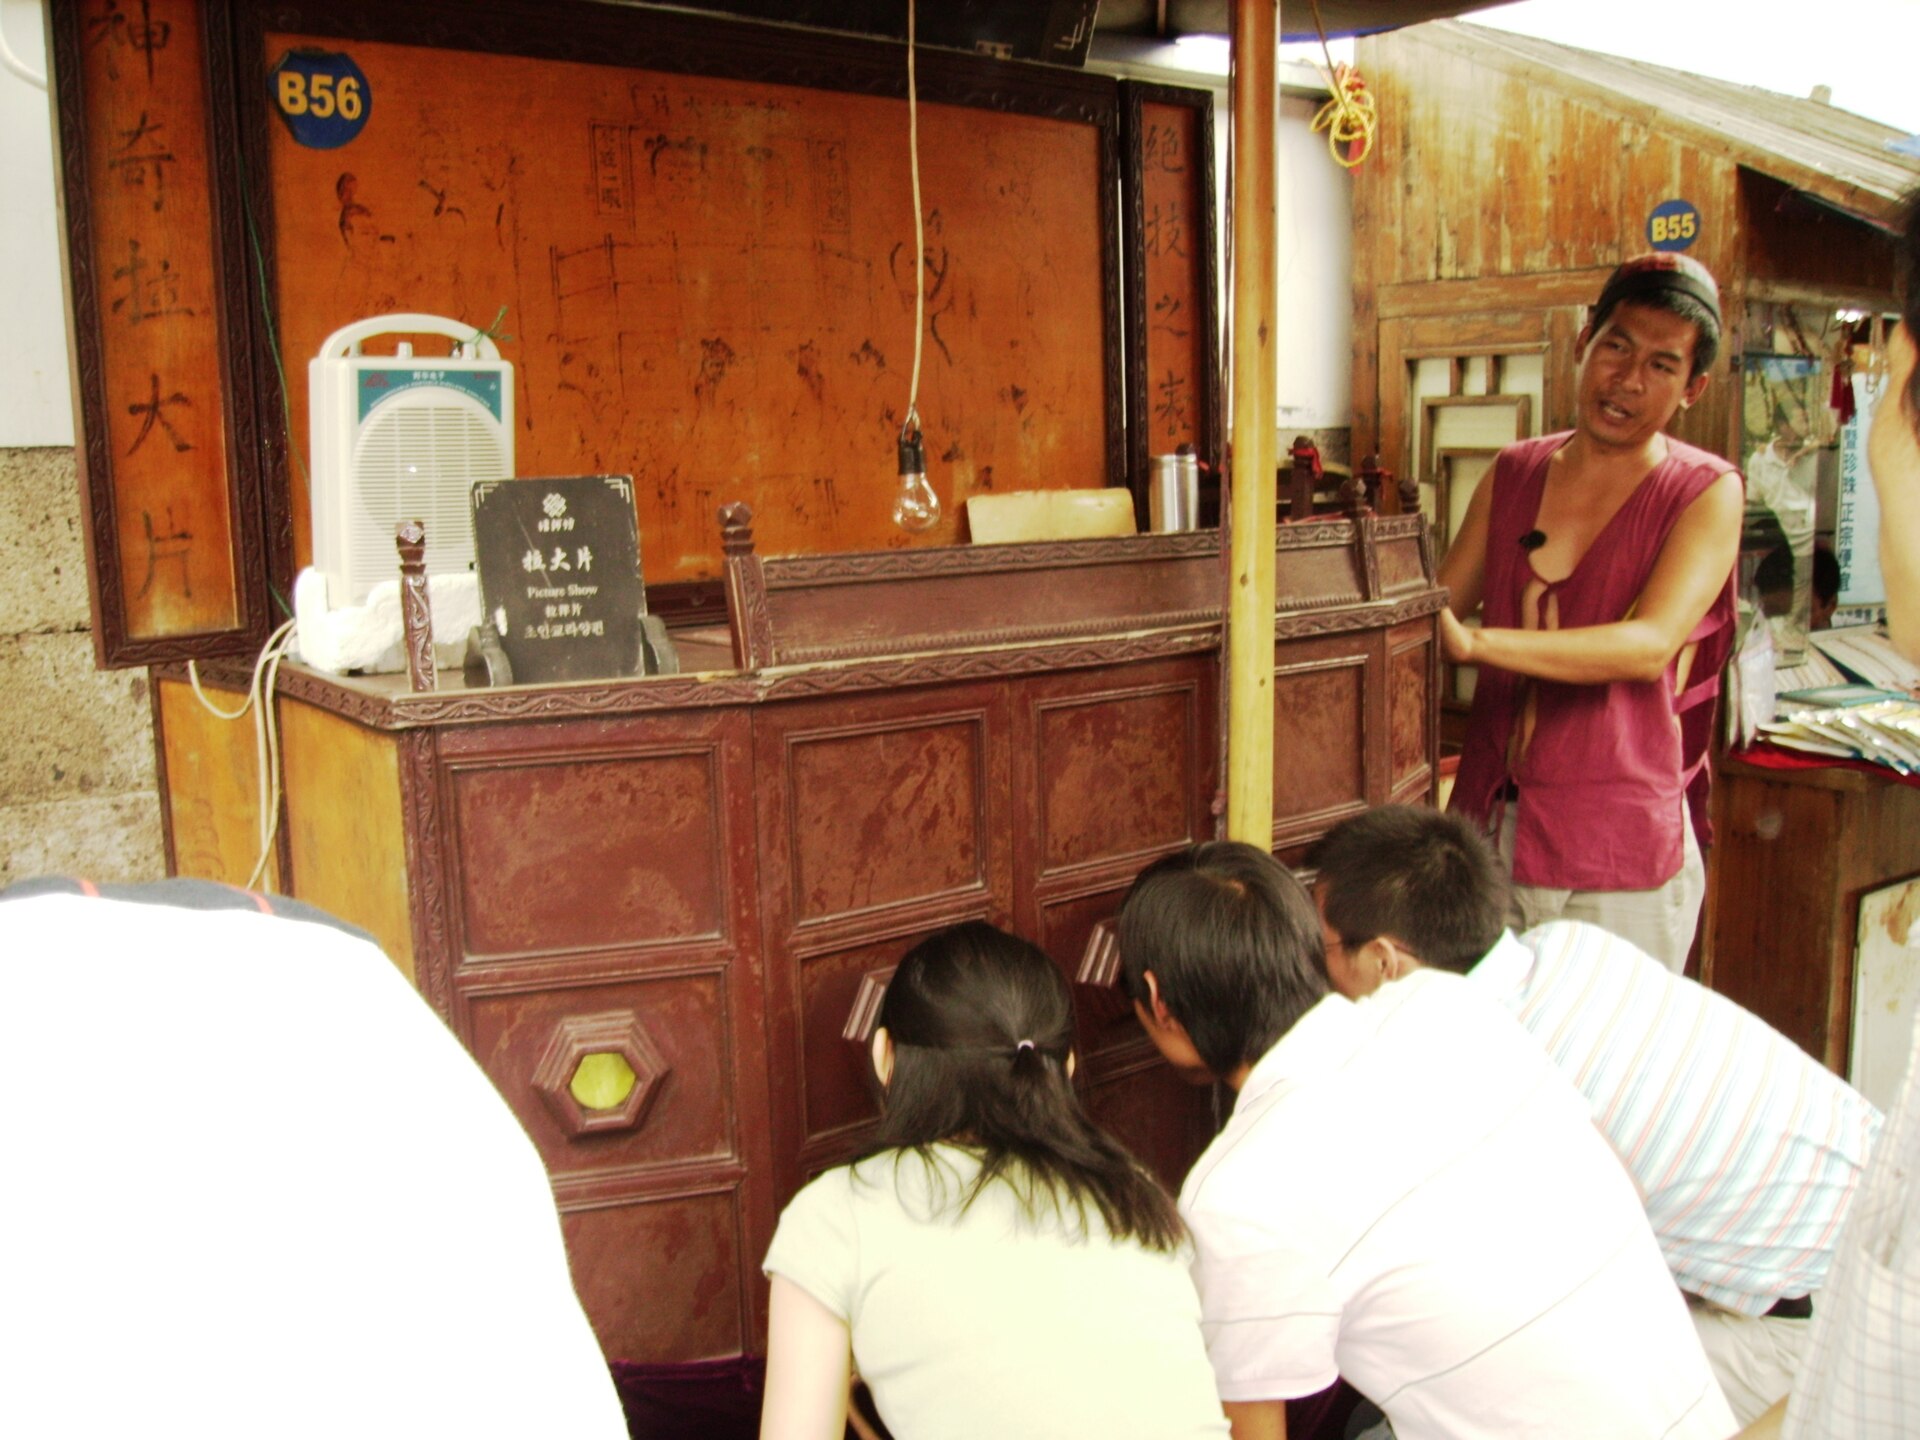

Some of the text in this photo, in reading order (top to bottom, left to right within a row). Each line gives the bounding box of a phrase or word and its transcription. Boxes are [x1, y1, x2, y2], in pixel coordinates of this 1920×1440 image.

[278, 71, 363, 121] B56
[1651, 212, 1696, 243] B55
[88, 0, 195, 602] 神奇拉大片
[522, 545, 594, 573] 拉大片
[527, 584, 599, 598] Picture Show
